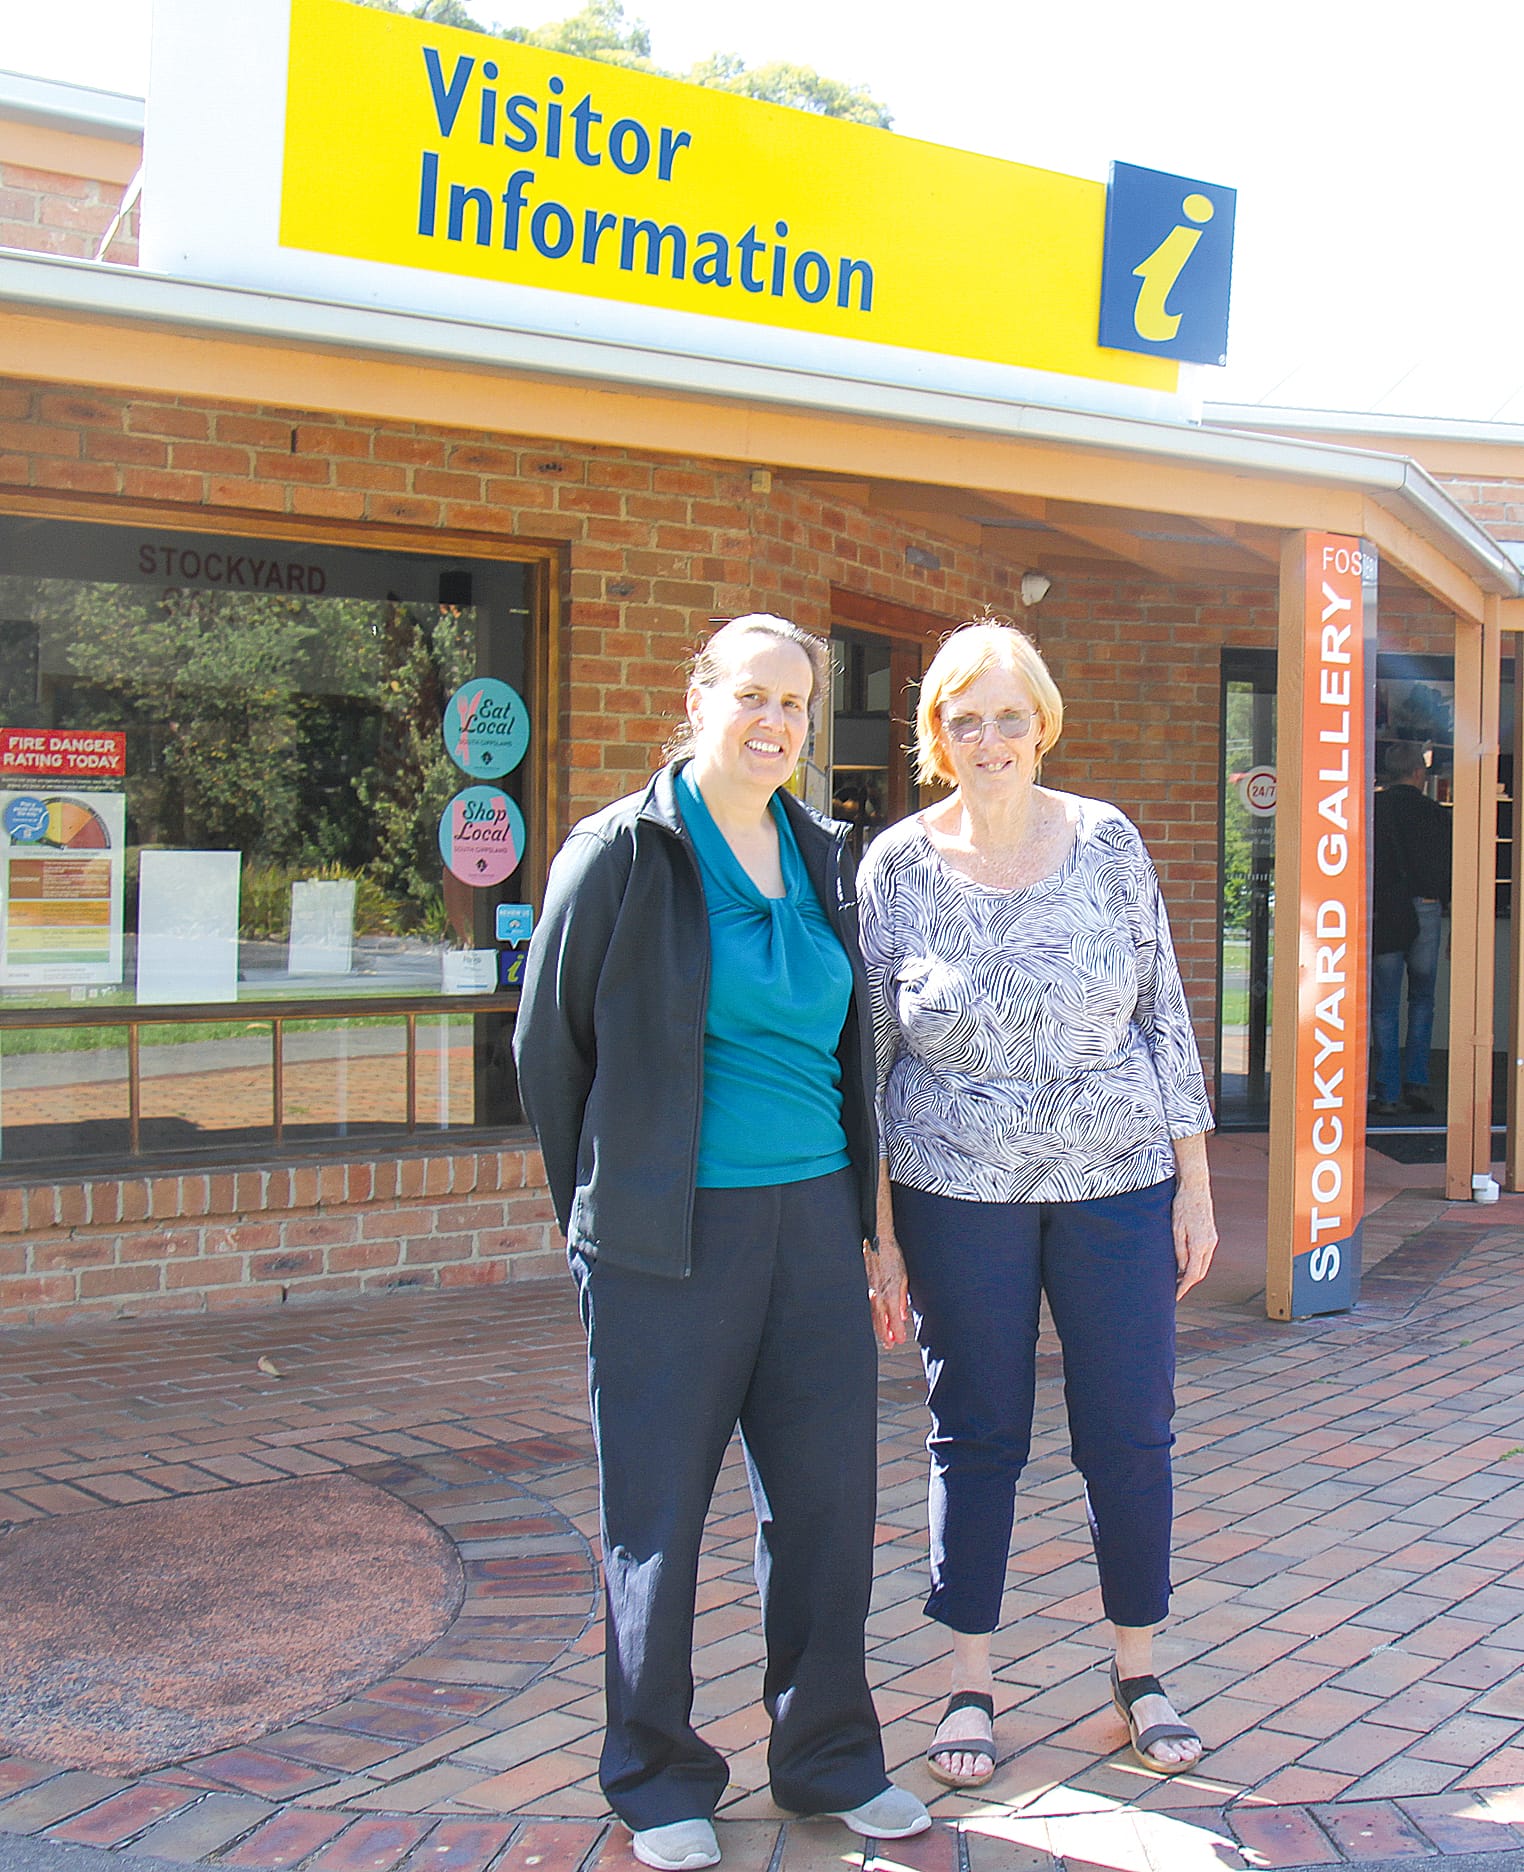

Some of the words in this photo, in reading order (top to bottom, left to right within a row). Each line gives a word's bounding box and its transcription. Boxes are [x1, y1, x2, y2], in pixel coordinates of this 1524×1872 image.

[422, 46, 692, 181] Visitor
[417, 151, 875, 312] Information
[139, 543, 326, 596] STOCKYARD
[479, 699, 511, 720] Eat
[459, 714, 515, 736] Local
[1317, 582, 1351, 876] GALLERY
[9, 736, 46, 751] FIRE
[49, 738, 116, 752] DANGER
[3, 753, 63, 767] RATING
[67, 755, 120, 769] TODAY
[1252, 785, 1276, 797] 24/7
[462, 801, 506, 826] Shop
[454, 822, 511, 843] Local
[1309, 900, 1347, 1282] STOCKYARD
